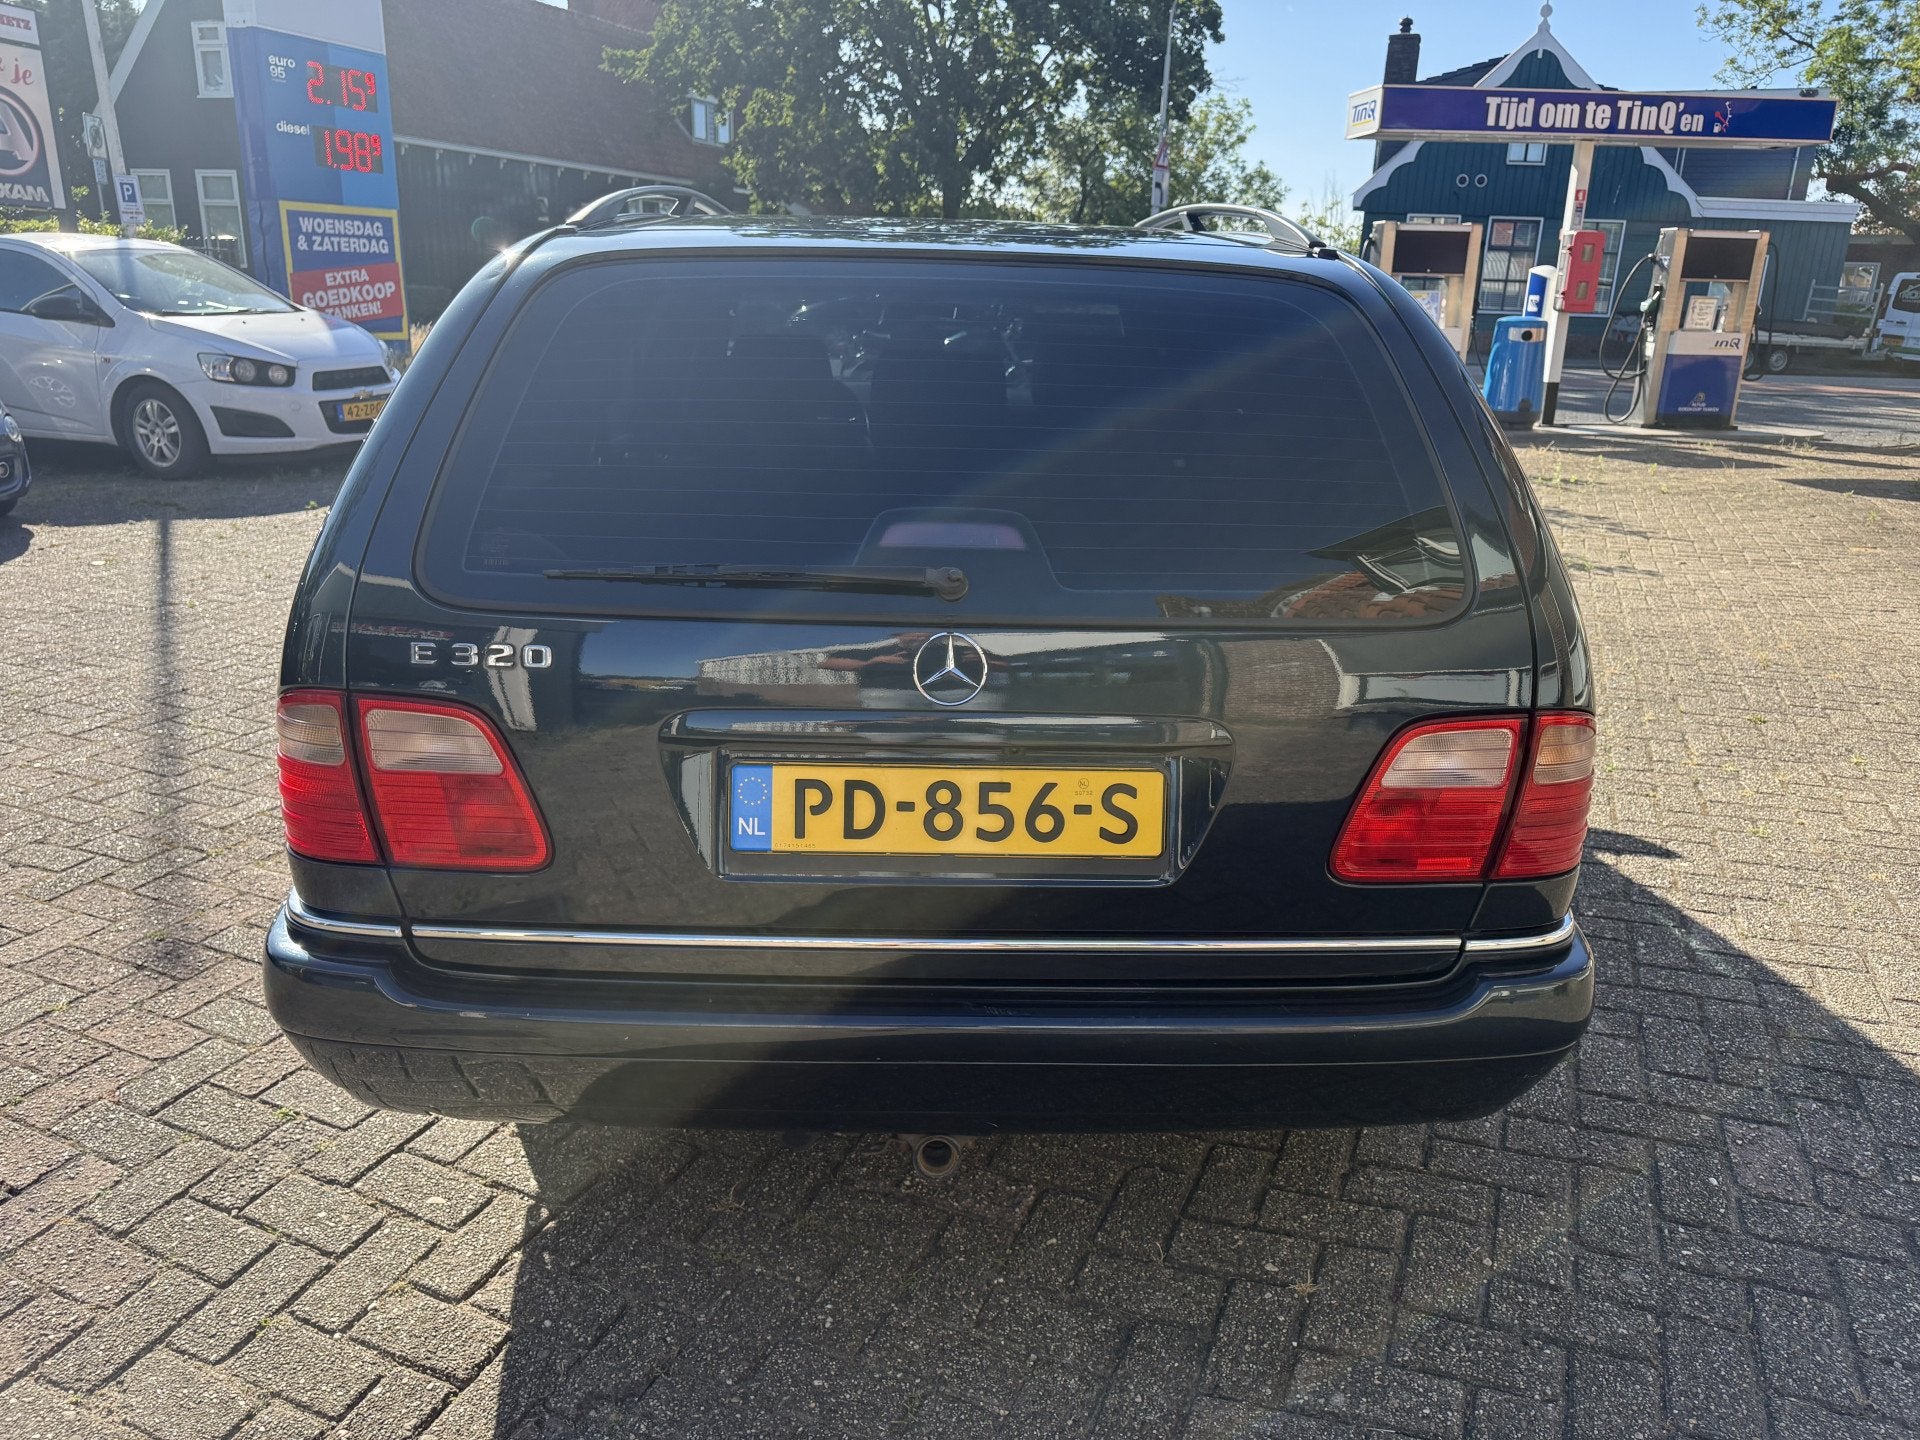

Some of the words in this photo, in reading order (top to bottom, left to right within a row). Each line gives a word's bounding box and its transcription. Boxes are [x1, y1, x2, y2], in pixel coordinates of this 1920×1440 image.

[269, 54, 296, 68] euro
[11, 57, 34, 86] je
[270, 66, 286, 79] 95
[1352, 99, 1377, 123] TinQ
[1486, 96, 1533, 128] Tijd
[1539, 103, 1581, 128] om
[1584, 100, 1611, 129] te
[1617, 100, 1704, 134] TinQ'en
[276, 120, 310, 135] diesel
[122, 184, 133, 201] P
[299, 217, 383, 237] WOENSDAG
[297, 237, 310, 251] &
[312, 235, 389, 253] ZATERDAG
[325, 268, 369, 286] EXTRA
[302, 281, 395, 308] GOEDKOOP
[410, 641, 438, 665] E
[451, 643, 553, 669] 320
[794, 778, 1139, 844] PD-856-S
[738, 816, 766, 836] NL
